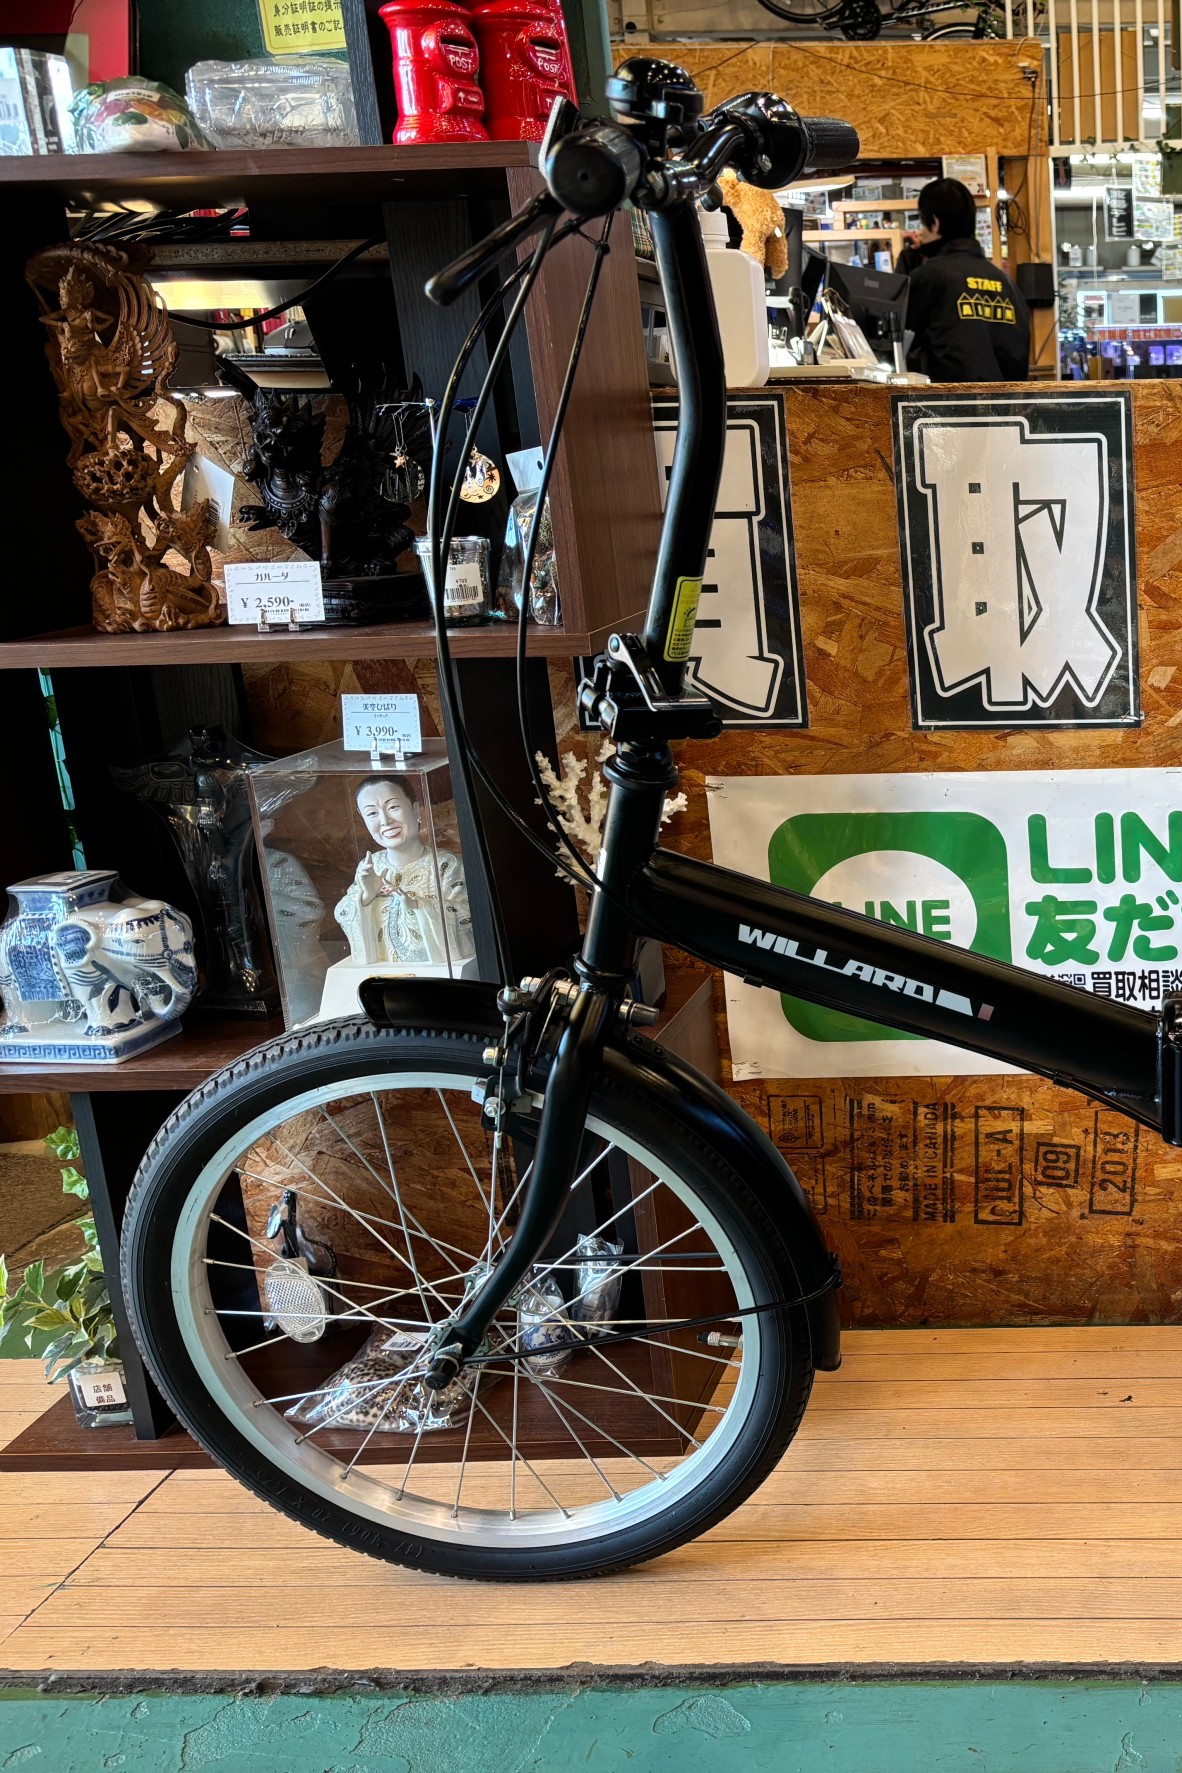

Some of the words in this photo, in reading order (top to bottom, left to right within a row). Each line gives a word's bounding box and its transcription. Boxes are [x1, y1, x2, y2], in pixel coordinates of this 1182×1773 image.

[274, 19, 345, 37] 販売証明書のご記
[448, 54, 472, 71] POST
[537, 58, 560, 74] POST
[966, 277, 1002, 292] STAFF
[915, 416, 1121, 712] 取
[254, 571, 289, 581] ガルーダ
[362, 703, 397, 711] 美空ひばり
[836, 900, 952, 941] NE
[738, 923, 934, 1004] WILLARD
[923, 1102, 938, 1160] CANADA
[923, 1164, 938, 1179] IN
[1041, 1149, 1072, 1182] 09
[923, 1183, 938, 1222] MADE
